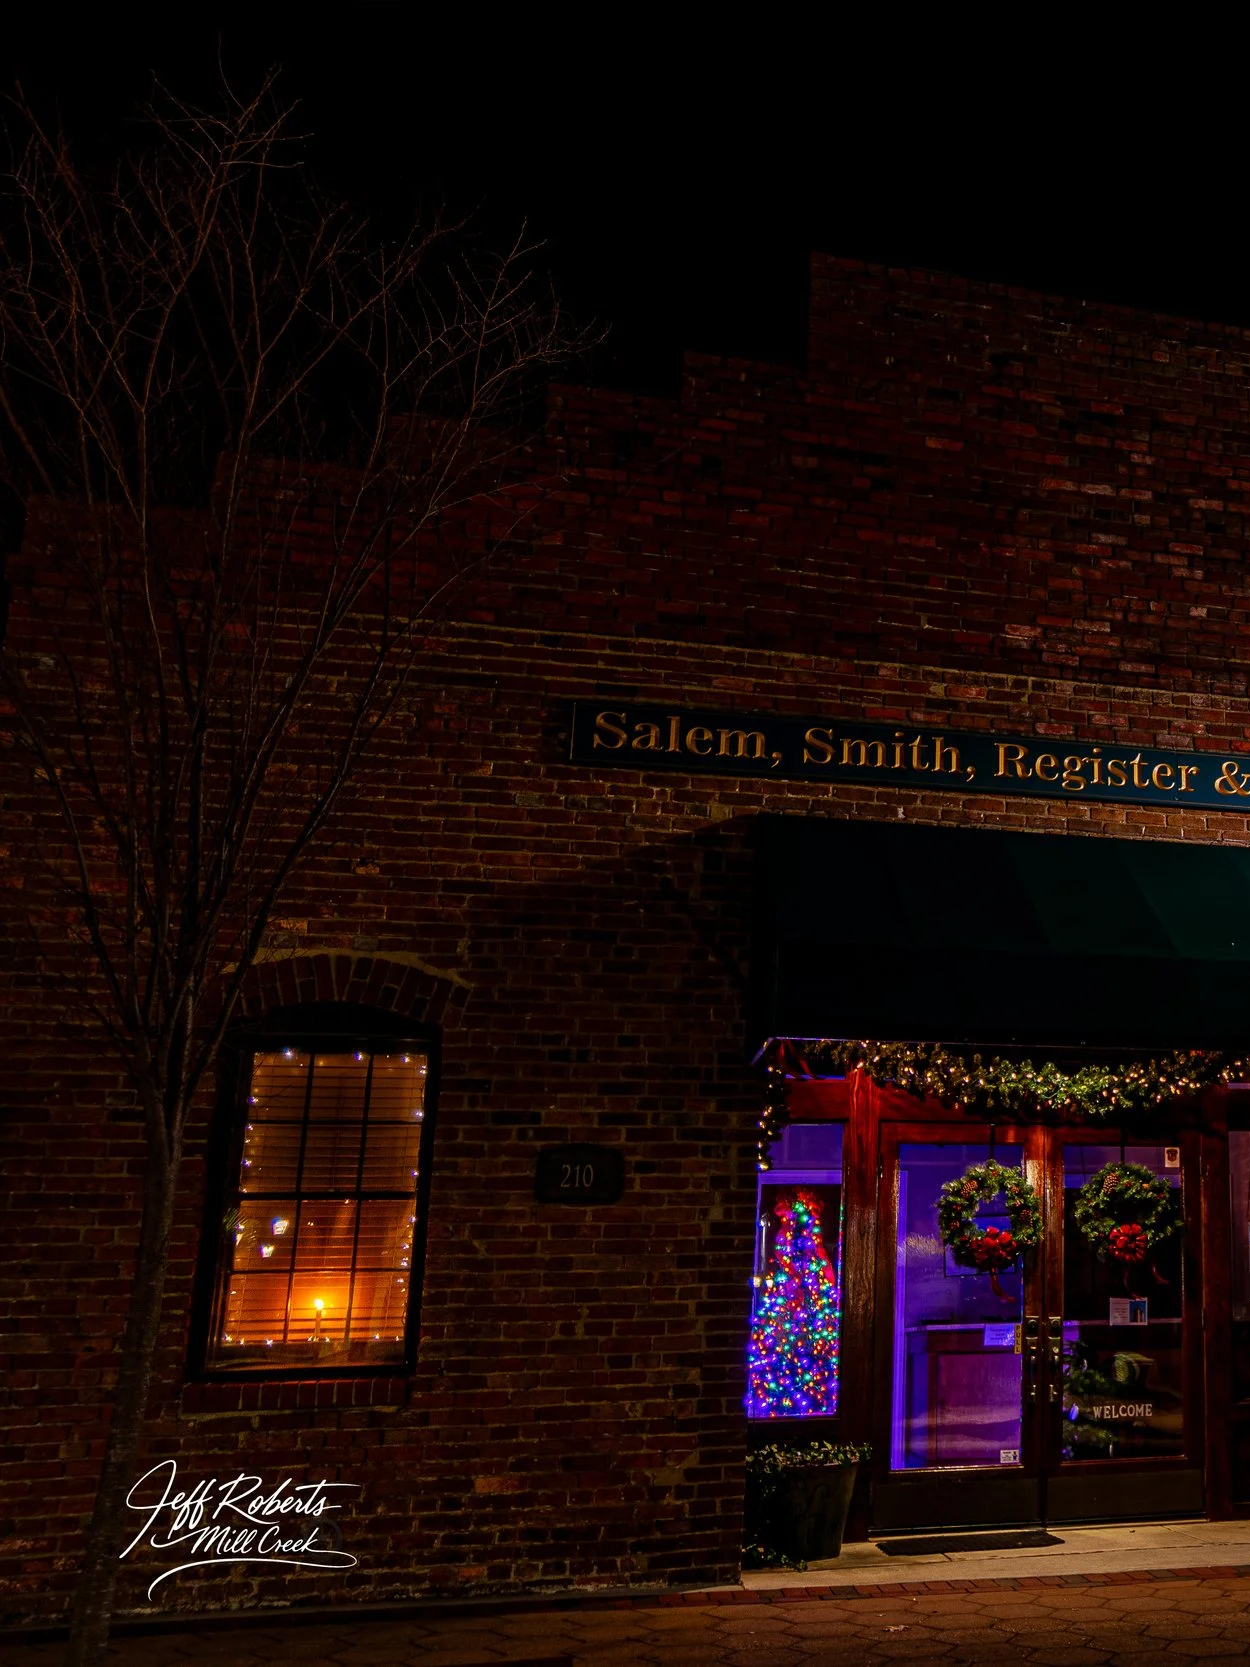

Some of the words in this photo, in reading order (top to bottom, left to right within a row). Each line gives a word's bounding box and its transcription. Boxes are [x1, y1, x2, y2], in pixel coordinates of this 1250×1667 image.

[594, 711, 782, 767] Salem,
[803, 728, 977, 782] Smith,
[995, 743, 1199, 792] Register
[560, 1164, 594, 1188] 210
[1093, 1403, 1153, 1419] WELCOME
